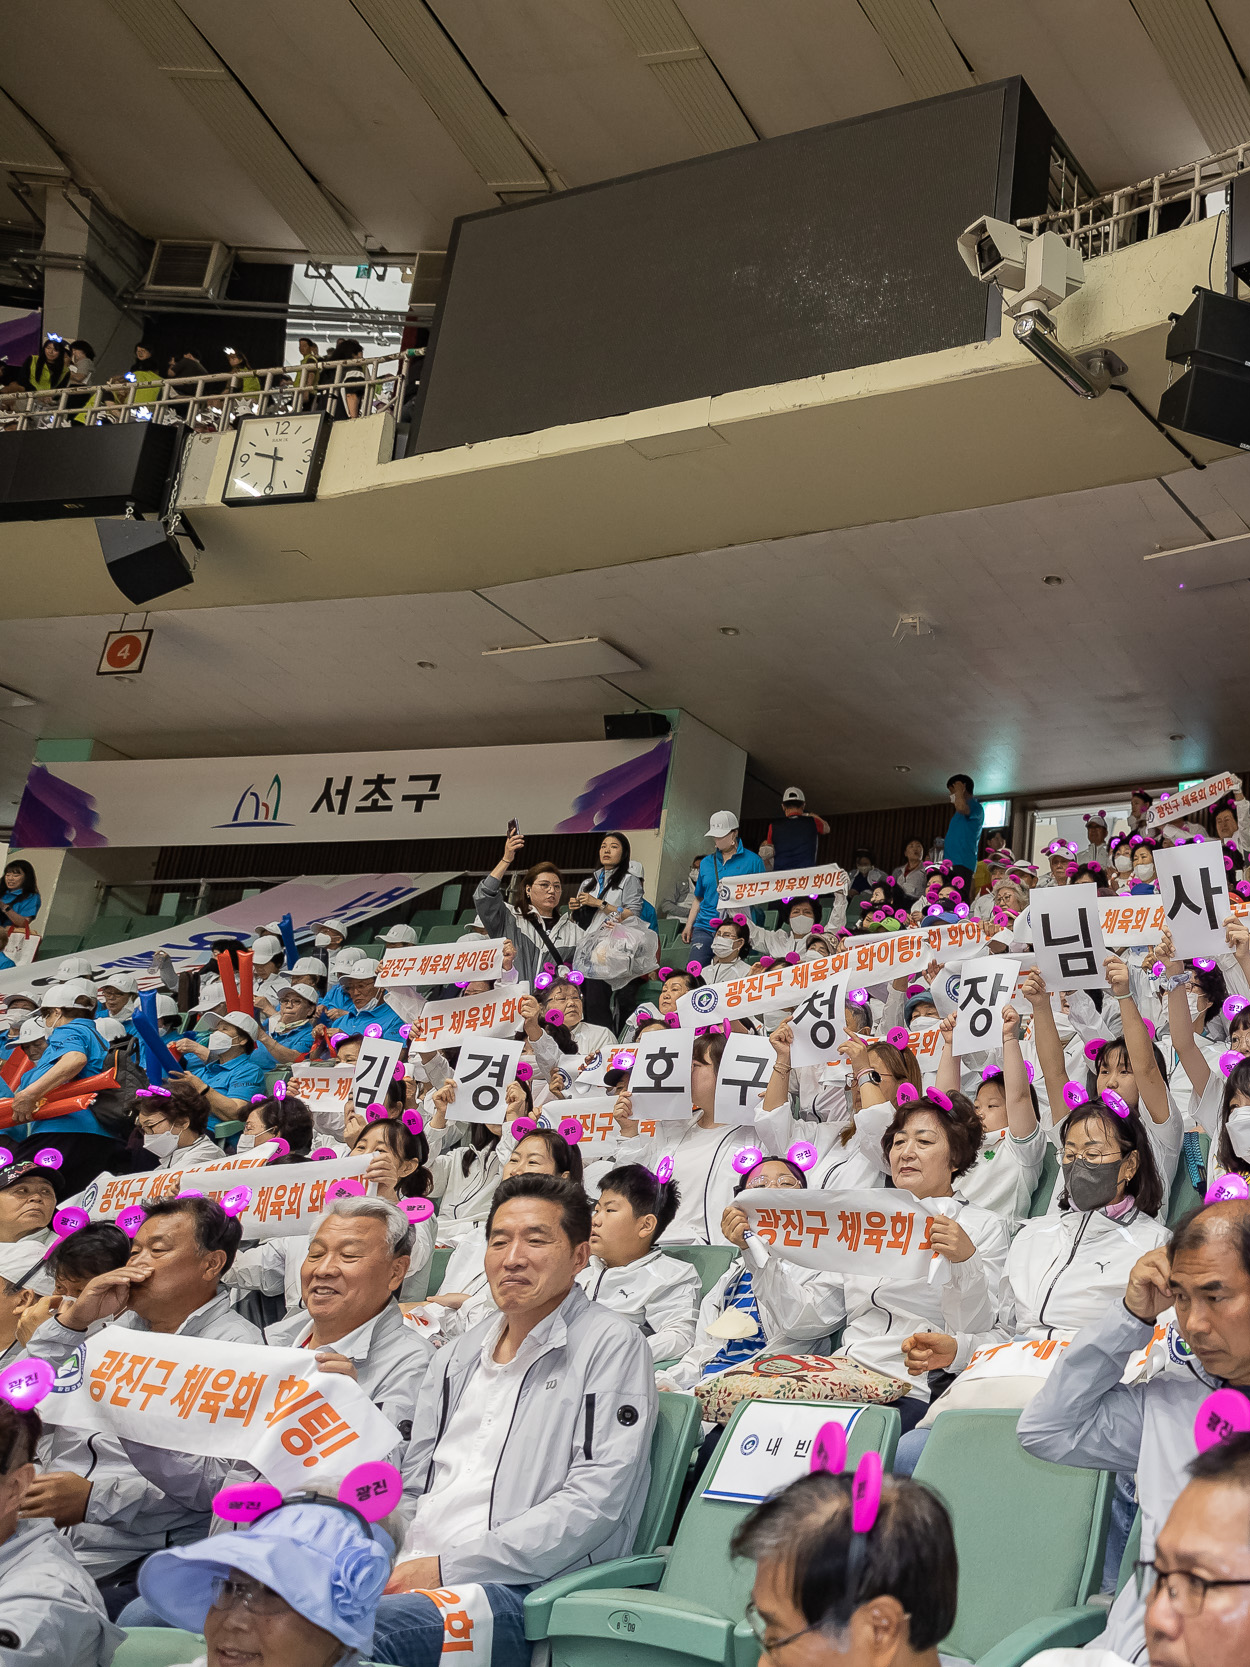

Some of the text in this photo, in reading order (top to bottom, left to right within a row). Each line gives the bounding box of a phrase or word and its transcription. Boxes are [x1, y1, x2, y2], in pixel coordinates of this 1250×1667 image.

[274, 421, 291, 436] 12
[117, 643, 130, 660] 4
[309, 773, 442, 815] 서초구
[1156, 798, 1181, 818] 광진구
[1181, 788, 1207, 808] 체육회
[735, 881, 769, 901] 광진구
[772, 876, 809, 894] 체육회
[1166, 867, 1223, 930] 사
[947, 923, 981, 947] 화이
[1101, 906, 1148, 934] 체육회
[1040, 907, 1098, 978] 님
[380, 949, 497, 979] 광진구 체육회 화이팅!
[725, 971, 784, 1008] 광진구
[791, 952, 849, 989] 체육회
[856, 935, 922, 971] 화이팅!
[792, 984, 839, 1049] 청
[959, 973, 1009, 1037] 장
[1228, 1004, 1243, 1012] 광진
[414, 1014, 446, 1042] 진구
[448, 1003, 496, 1036] 체육회
[892, 1032, 903, 1043] 광진
[355, 1055, 390, 1109] 김
[460, 1054, 510, 1110] 경
[632, 1047, 685, 1093] 호
[722, 1055, 769, 1106] 구
[296, 1077, 330, 1101] 진구
[1068, 1092, 1080, 1103] 광진
[564, 1126, 576, 1136] 광진
[795, 1150, 811, 1161] 광진
[99, 1176, 150, 1214] 광진구
[253, 1182, 305, 1222] 체육회
[406, 1204, 426, 1212] 광진
[60, 1216, 79, 1228] 광진
[123, 1214, 141, 1226] 광진
[754, 1207, 830, 1249] 광진구
[837, 1210, 915, 1254] 체육회
[7, 1372, 39, 1393] 광진
[89, 1349, 178, 1410] 광진구
[170, 1363, 266, 1427] 체육회
[355, 1479, 388, 1502] 광진
